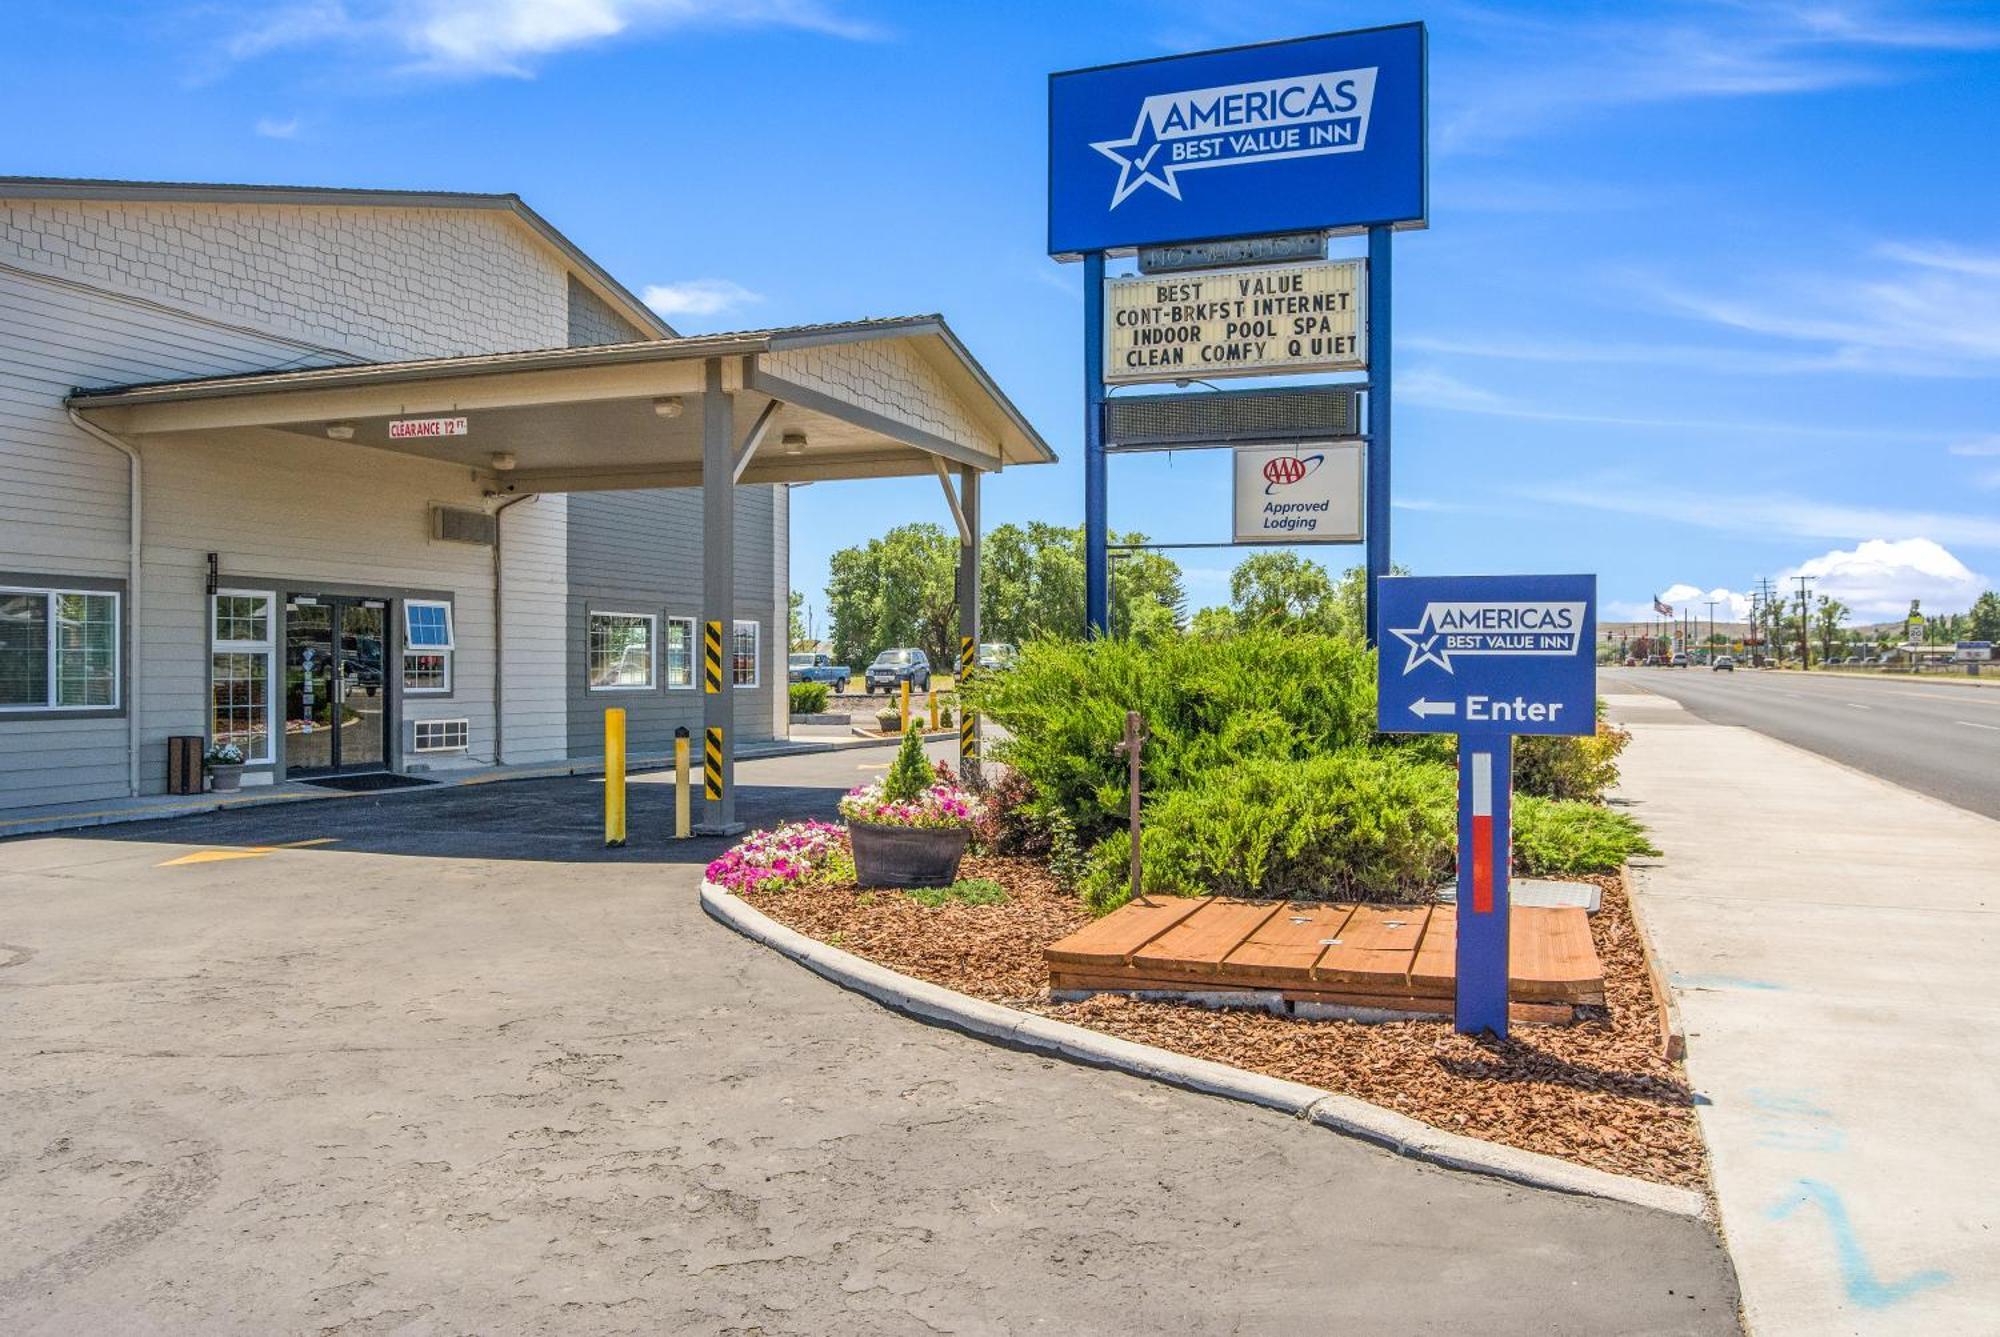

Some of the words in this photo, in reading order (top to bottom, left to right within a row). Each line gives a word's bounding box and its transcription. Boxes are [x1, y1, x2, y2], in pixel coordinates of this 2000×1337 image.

[1161, 79, 1357, 134] AMERICAS
[1173, 137, 1224, 161] BEST
[1230, 128, 1301, 153] VALUE
[1309, 123, 1352, 146] INN
[1156, 283, 1203, 304] BEST
[1239, 275, 1303, 297] VALUE
[1116, 301, 1245, 326] CONT-BRKFST
[1253, 292, 1350, 317] INTERNET
[1133, 326, 1201, 346] INDOOR
[1226, 320, 1277, 339] POOL
[1294, 317, 1331, 336] SPA
[1126, 347, 1184, 367] CLEAN
[1201, 341, 1267, 362] COMFY
[391, 421, 440, 437] CLEARANCE
[444, 421, 455, 434] 12
[1267, 456, 1303, 484] AAA
[1263, 500, 1330, 515] Approved
[1263, 516, 1317, 531] Lodging
[1439, 608, 1573, 629] AMERICAS
[1446, 635, 1483, 649] BEST
[1486, 635, 1535, 649] VALUE
[1540, 635, 1569, 649] INN
[1466, 695, 1564, 722] Enter
